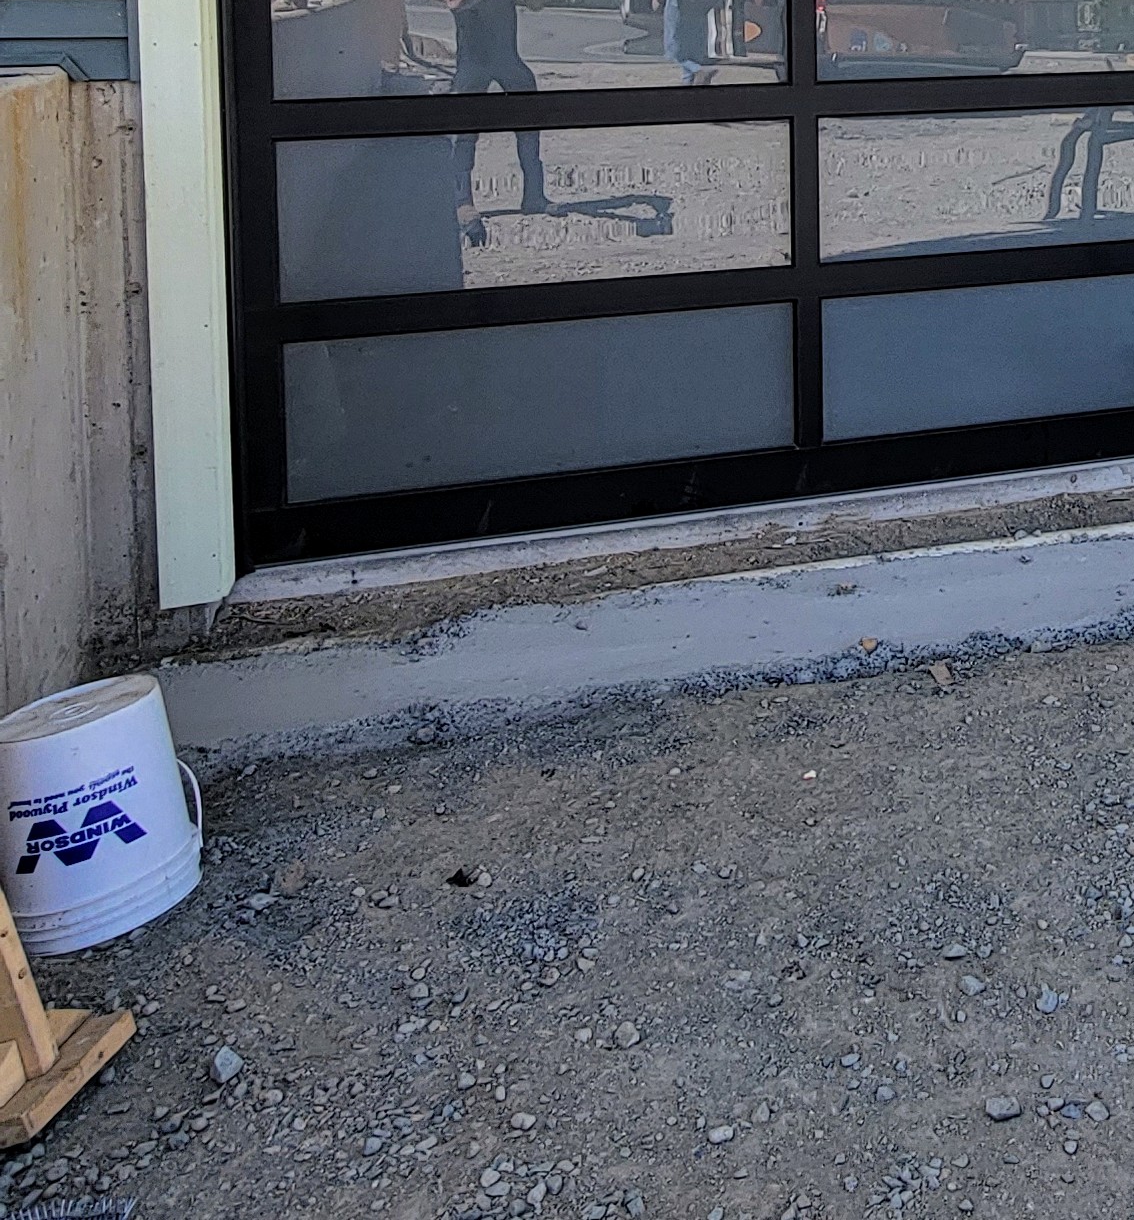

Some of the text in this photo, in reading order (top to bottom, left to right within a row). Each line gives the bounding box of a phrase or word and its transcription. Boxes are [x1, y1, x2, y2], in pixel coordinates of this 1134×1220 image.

[73, 775, 138, 807] Windsor
[9, 801, 68, 821] Plywood
[26, 813, 131, 854] WINDSOR
